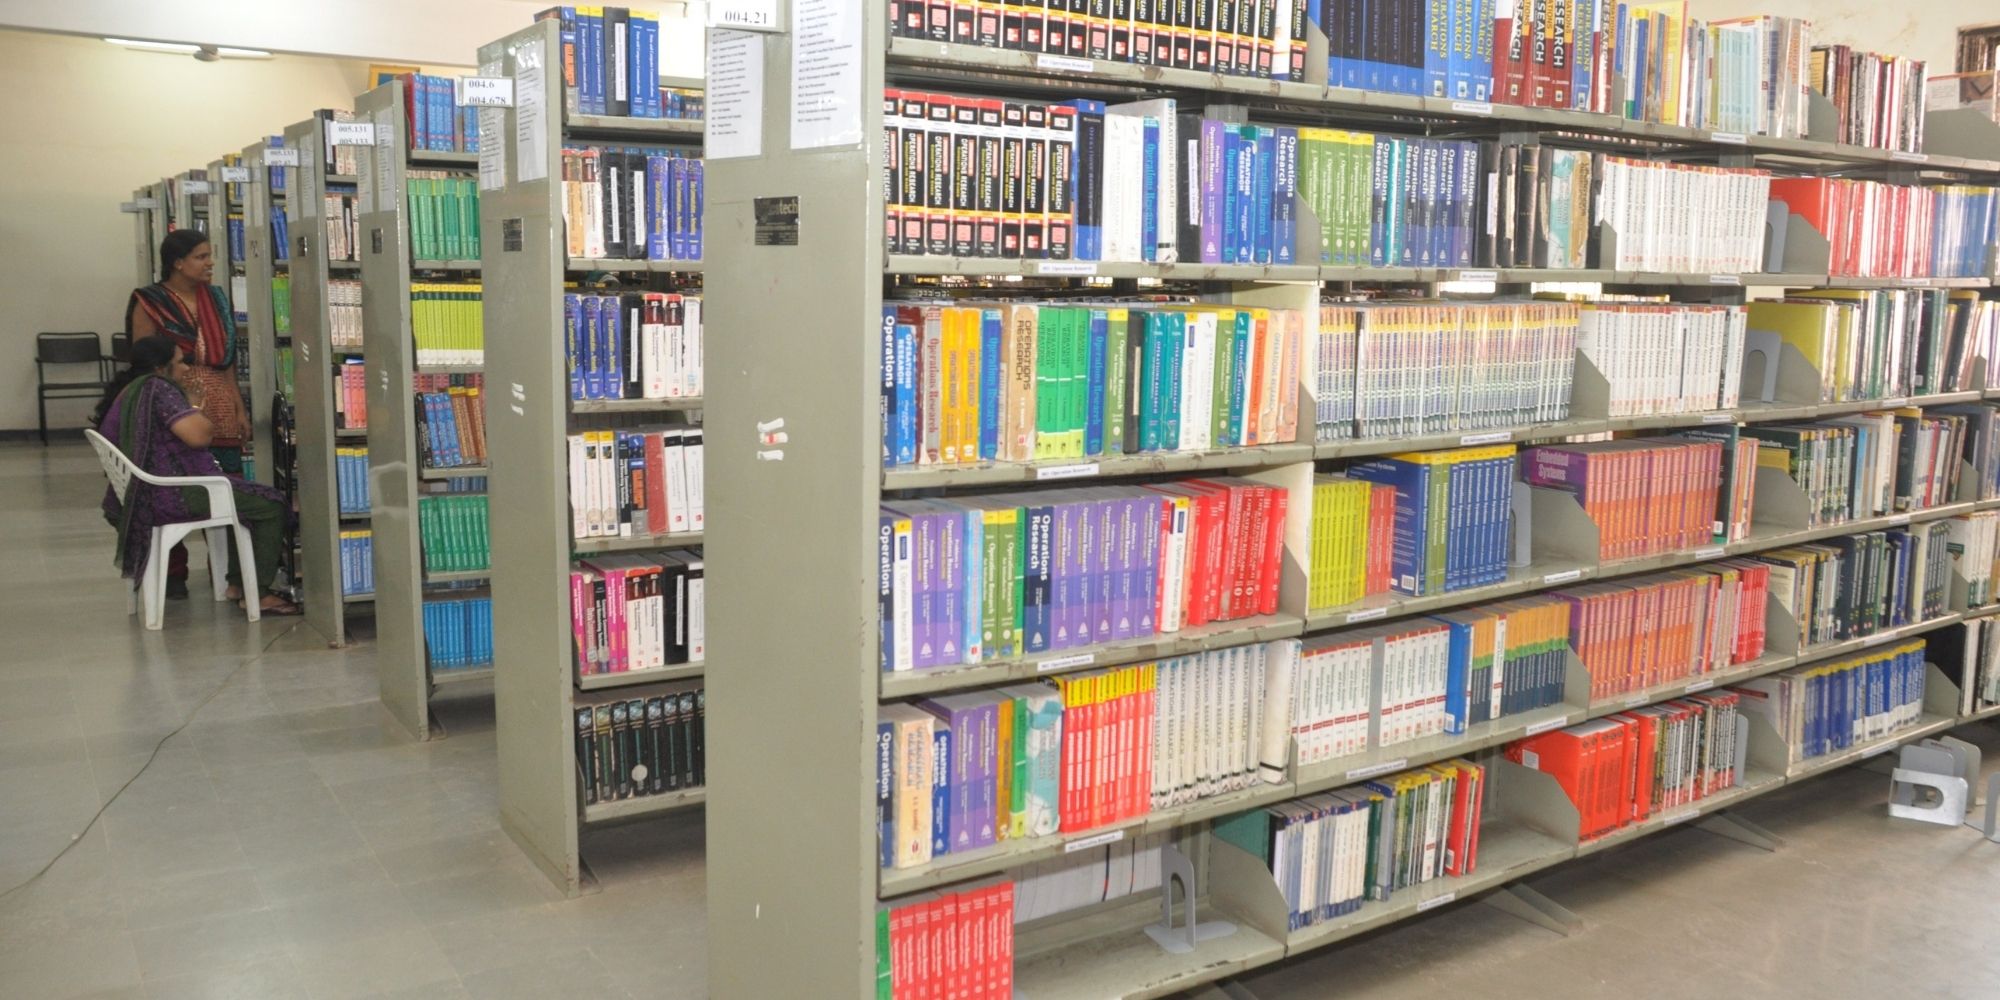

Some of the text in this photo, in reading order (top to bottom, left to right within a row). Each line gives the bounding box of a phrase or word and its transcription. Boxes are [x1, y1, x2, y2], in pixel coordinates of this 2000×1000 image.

[725, 11, 767, 24] 004.21
[469, 80, 494, 88] 004.6
[1279, 136, 1287, 185] Research
[1286, 136, 1296, 197] Operations
[1375, 142, 1383, 189] Research
[1381, 143, 1390, 202] Operations
[1410, 146, 1420, 203] Operations
[1422, 148, 1430, 194] Research
[1428, 149, 1437, 206] Operations
[1446, 149, 1455, 206] Operations
[1468, 151, 1477, 206] Operations
[883, 316, 895, 388] Operations
[927, 338, 940, 432] Operations Research
[1536, 449, 1568, 467] Embedded
[1537, 463, 1566, 480] Systems
[880, 526, 891, 595] Operations
[1031, 516, 1041, 569] Research
[1040, 515, 1050, 581] Operations
[881, 732, 891, 799] Operations
